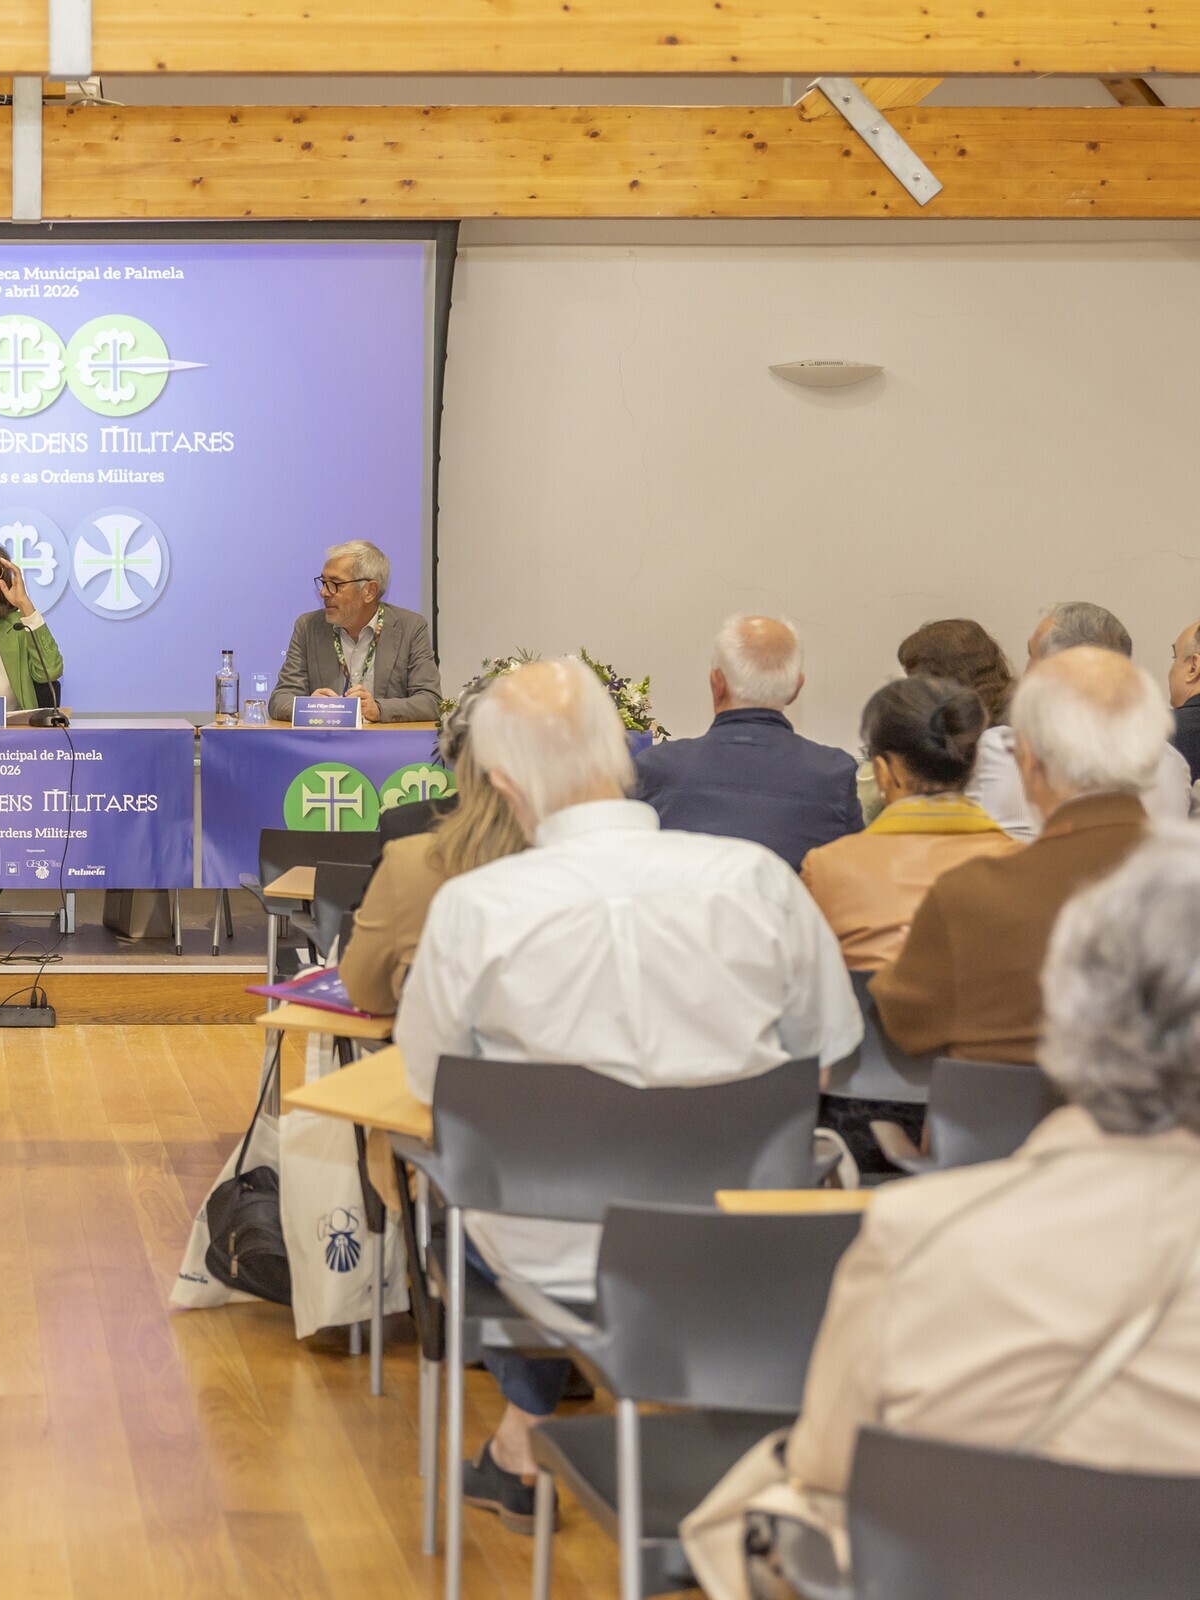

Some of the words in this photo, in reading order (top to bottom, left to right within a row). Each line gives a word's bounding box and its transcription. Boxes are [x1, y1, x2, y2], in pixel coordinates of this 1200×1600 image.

[24, 267, 100, 282] Municipal
[103, 267, 121, 280] de
[125, 267, 184, 280] Palmela
[5, 285, 40, 298] abril
[43, 285, 79, 298] 2026
[11, 473, 20, 484] e
[23, 473, 38, 484] as
[41, 469, 95, 484] Ordens
[98, 469, 164, 483] Militares
[40, 750, 54, 761] de
[35, 828, 88, 839] Militares
[68, 868, 106, 876] Palmela
